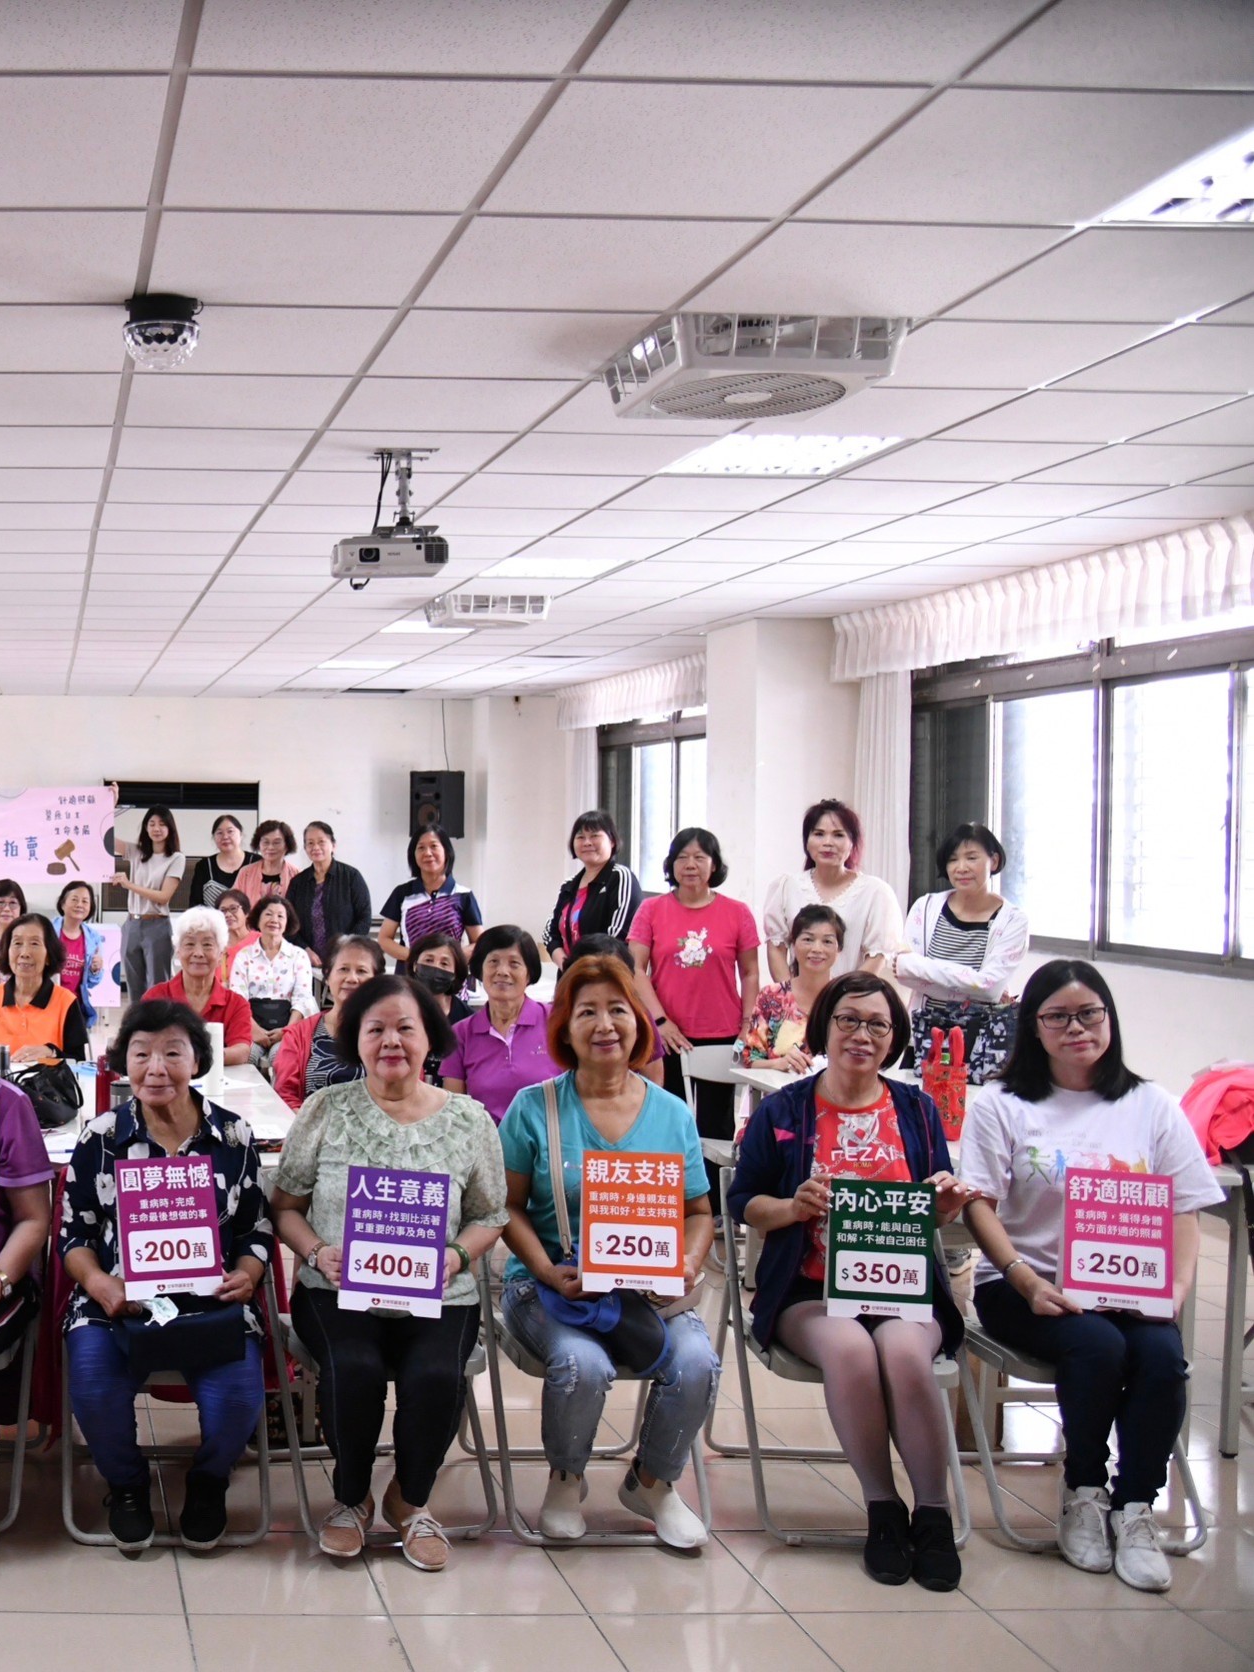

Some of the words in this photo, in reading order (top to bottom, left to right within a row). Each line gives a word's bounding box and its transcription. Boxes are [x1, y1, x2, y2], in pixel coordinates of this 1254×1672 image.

[120, 1162, 211, 1193] 圓夢無憾
[586, 1158, 680, 1187] 親友支持
[350, 1174, 445, 1208] 人生意義
[834, 1187, 931, 1216] 內心平安
[1068, 1175, 1169, 1208] 舒適照顧
